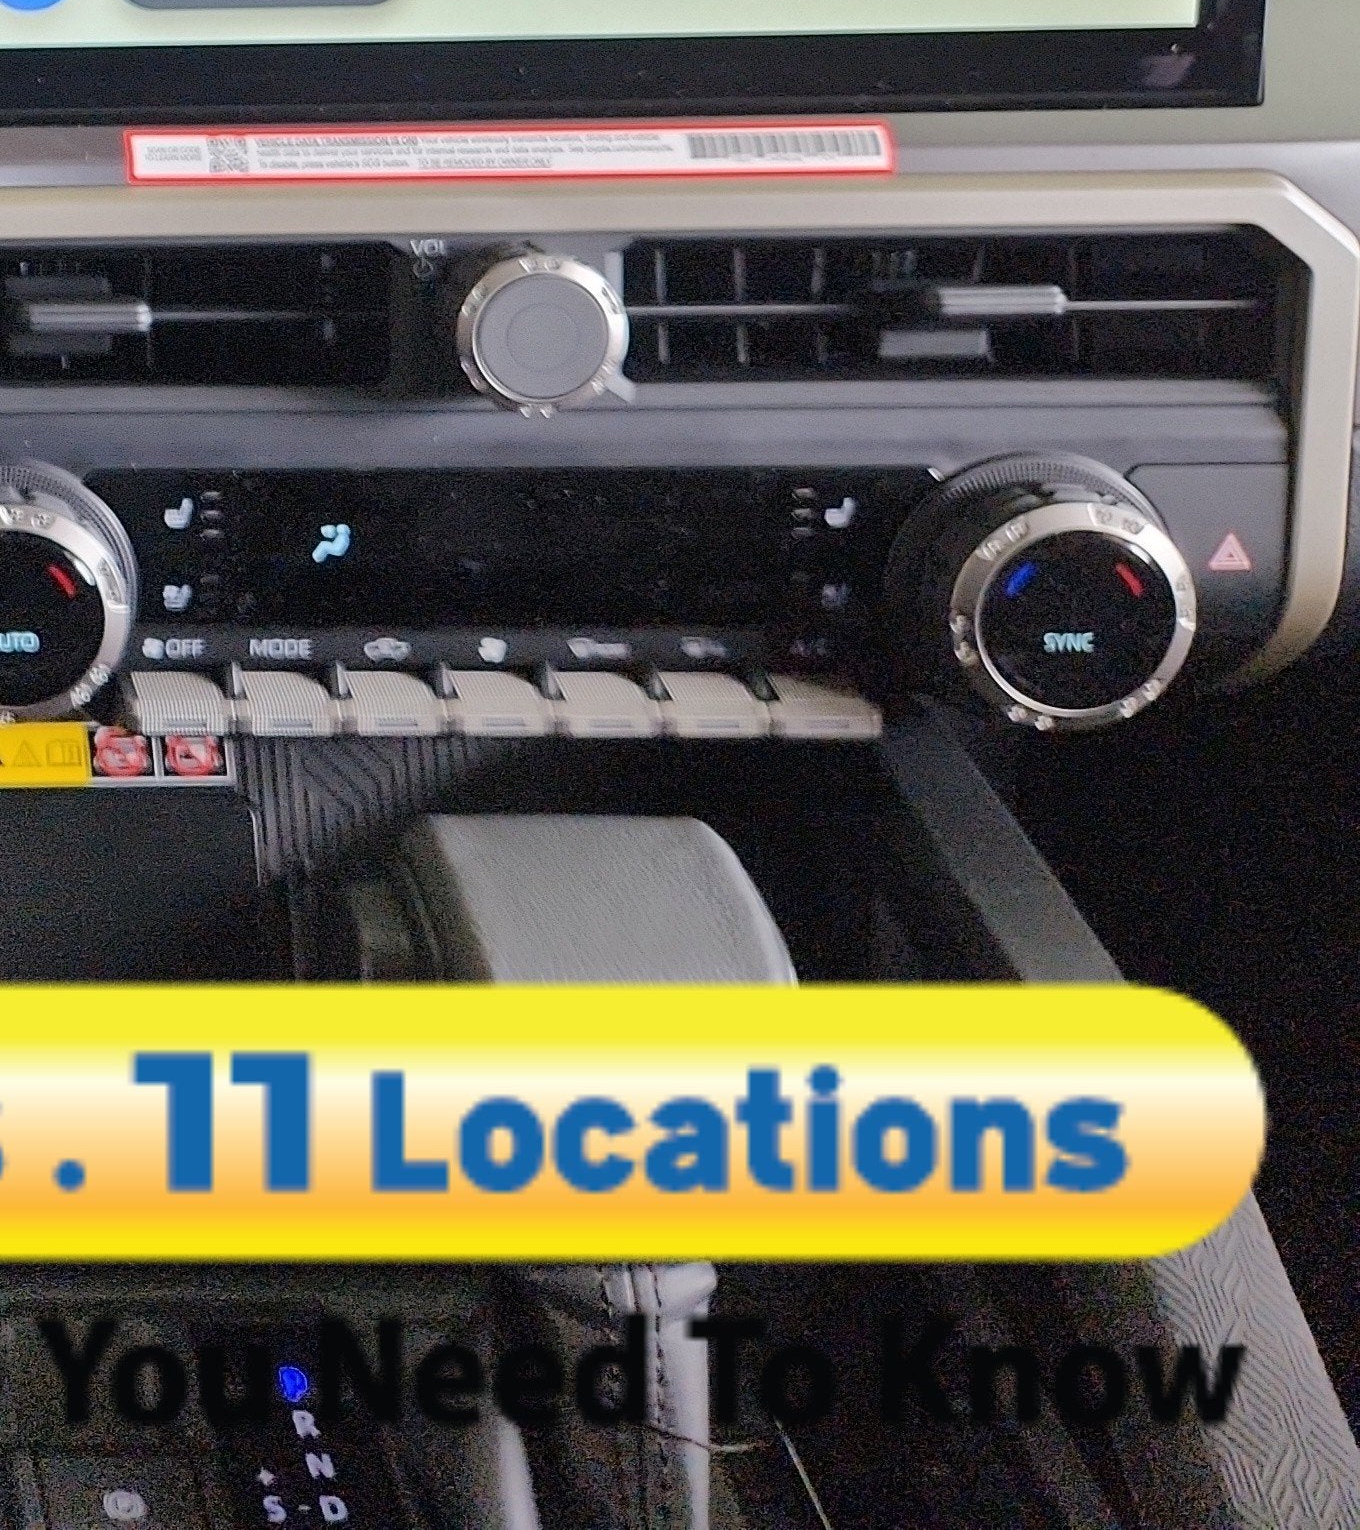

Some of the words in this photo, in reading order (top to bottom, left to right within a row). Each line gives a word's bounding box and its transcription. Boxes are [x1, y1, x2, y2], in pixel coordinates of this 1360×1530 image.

[165, 638, 207, 660] OFF
[249, 638, 314, 660] MODE
[1042, 631, 1096, 654] SYNC
[292, 1410, 321, 1439] R
[305, 1453, 335, 1479] N
[263, 1496, 287, 1523] S
[319, 1496, 349, 1523] D
